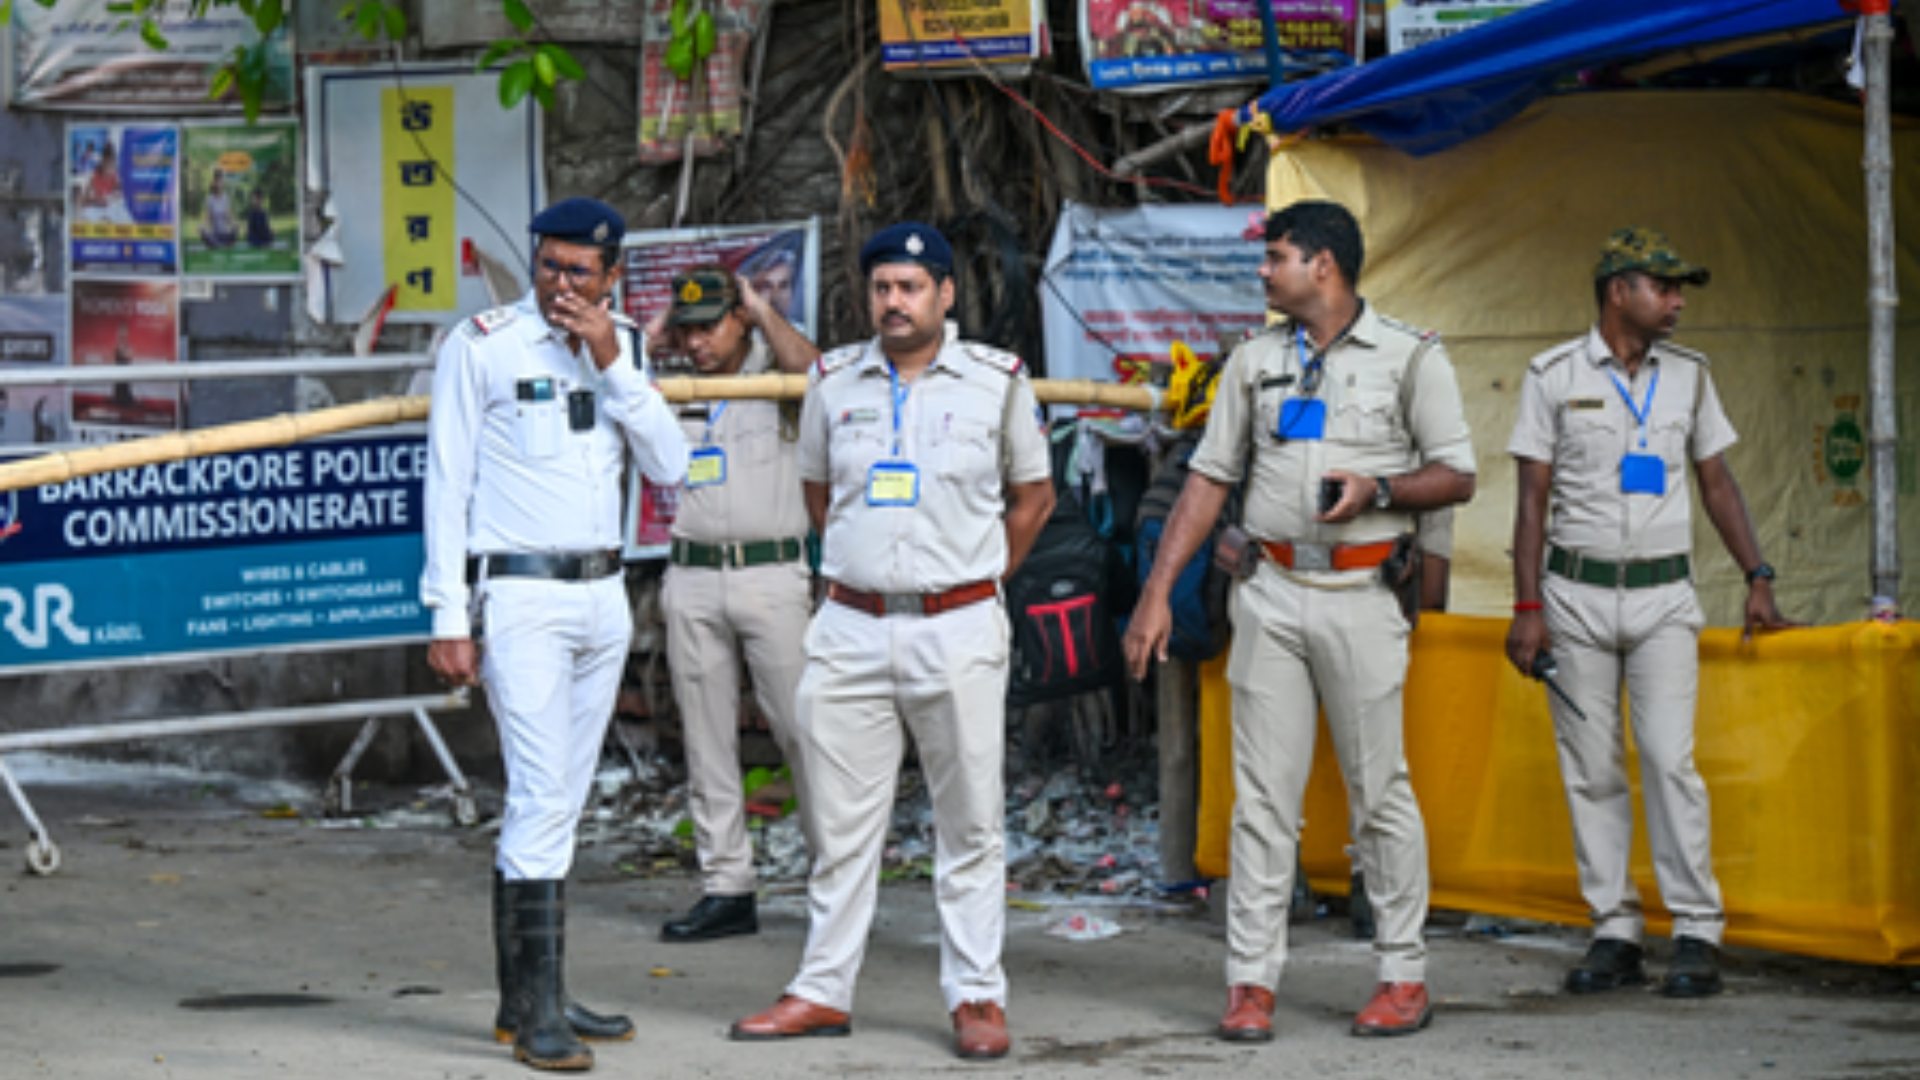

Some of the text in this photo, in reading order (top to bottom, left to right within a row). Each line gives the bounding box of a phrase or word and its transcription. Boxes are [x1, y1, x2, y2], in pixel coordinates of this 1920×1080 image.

[313, 444, 428, 486] POLICE
[63, 489, 408, 547] COMMISSIONERATE
[241, 565, 291, 584] WIRES
[307, 558, 367, 579] CABLES
[203, 579, 404, 611] SWITCHES SWITCHGEARS
[187, 600, 420, 636] FANS LIGHTING APPLIANCES
